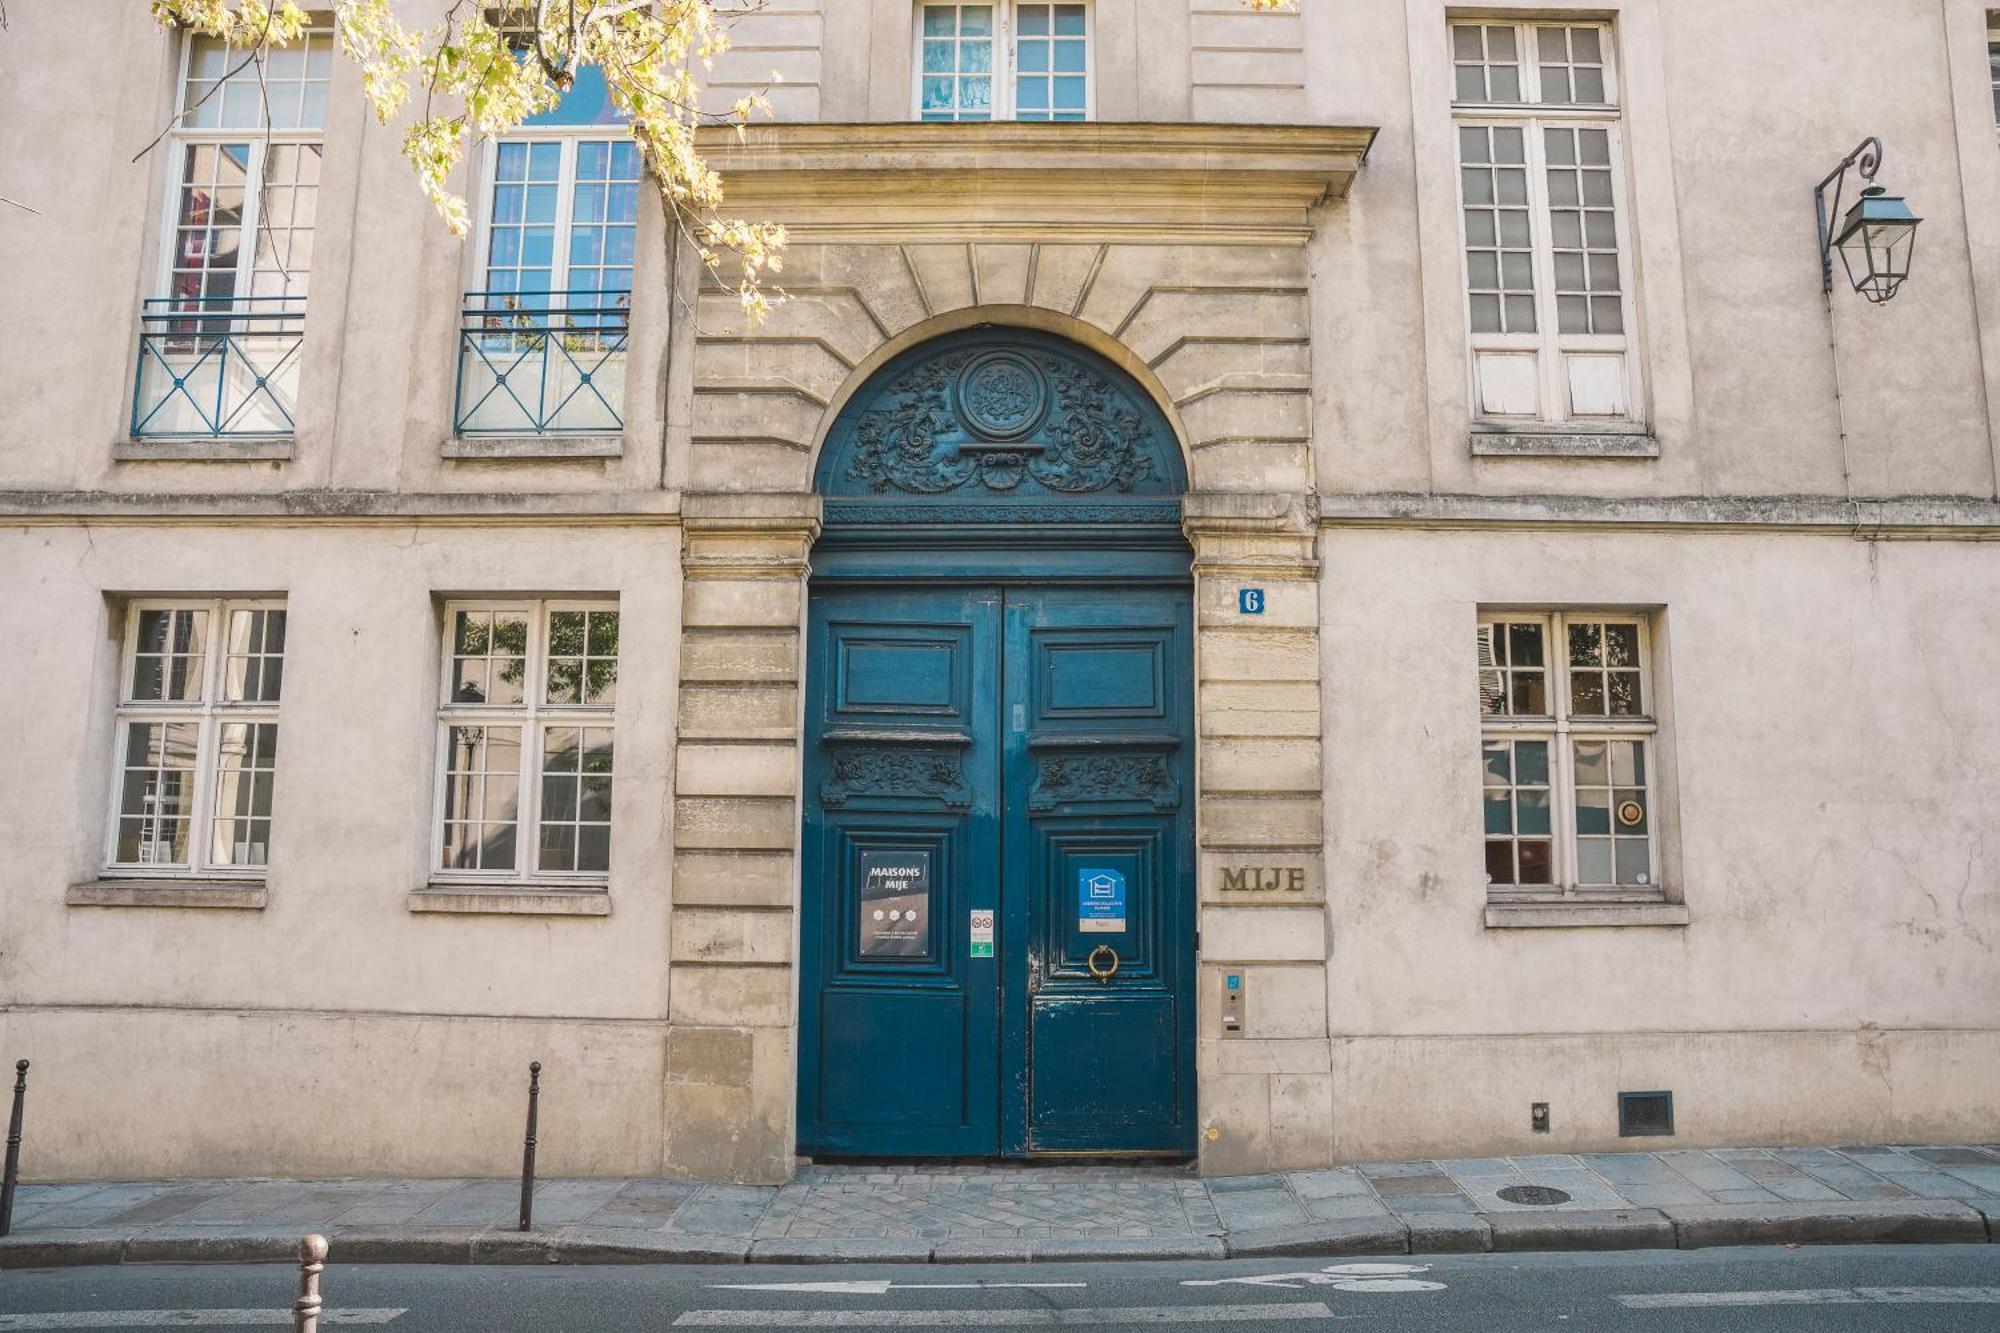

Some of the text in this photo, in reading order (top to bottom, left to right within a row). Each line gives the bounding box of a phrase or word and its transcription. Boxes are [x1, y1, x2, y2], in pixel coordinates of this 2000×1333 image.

[1245, 591, 1258, 611] 6
[871, 867, 920, 877] MAISONS
[1219, 867, 1304, 891] MIJE
[885, 880, 909, 891] MIJE
